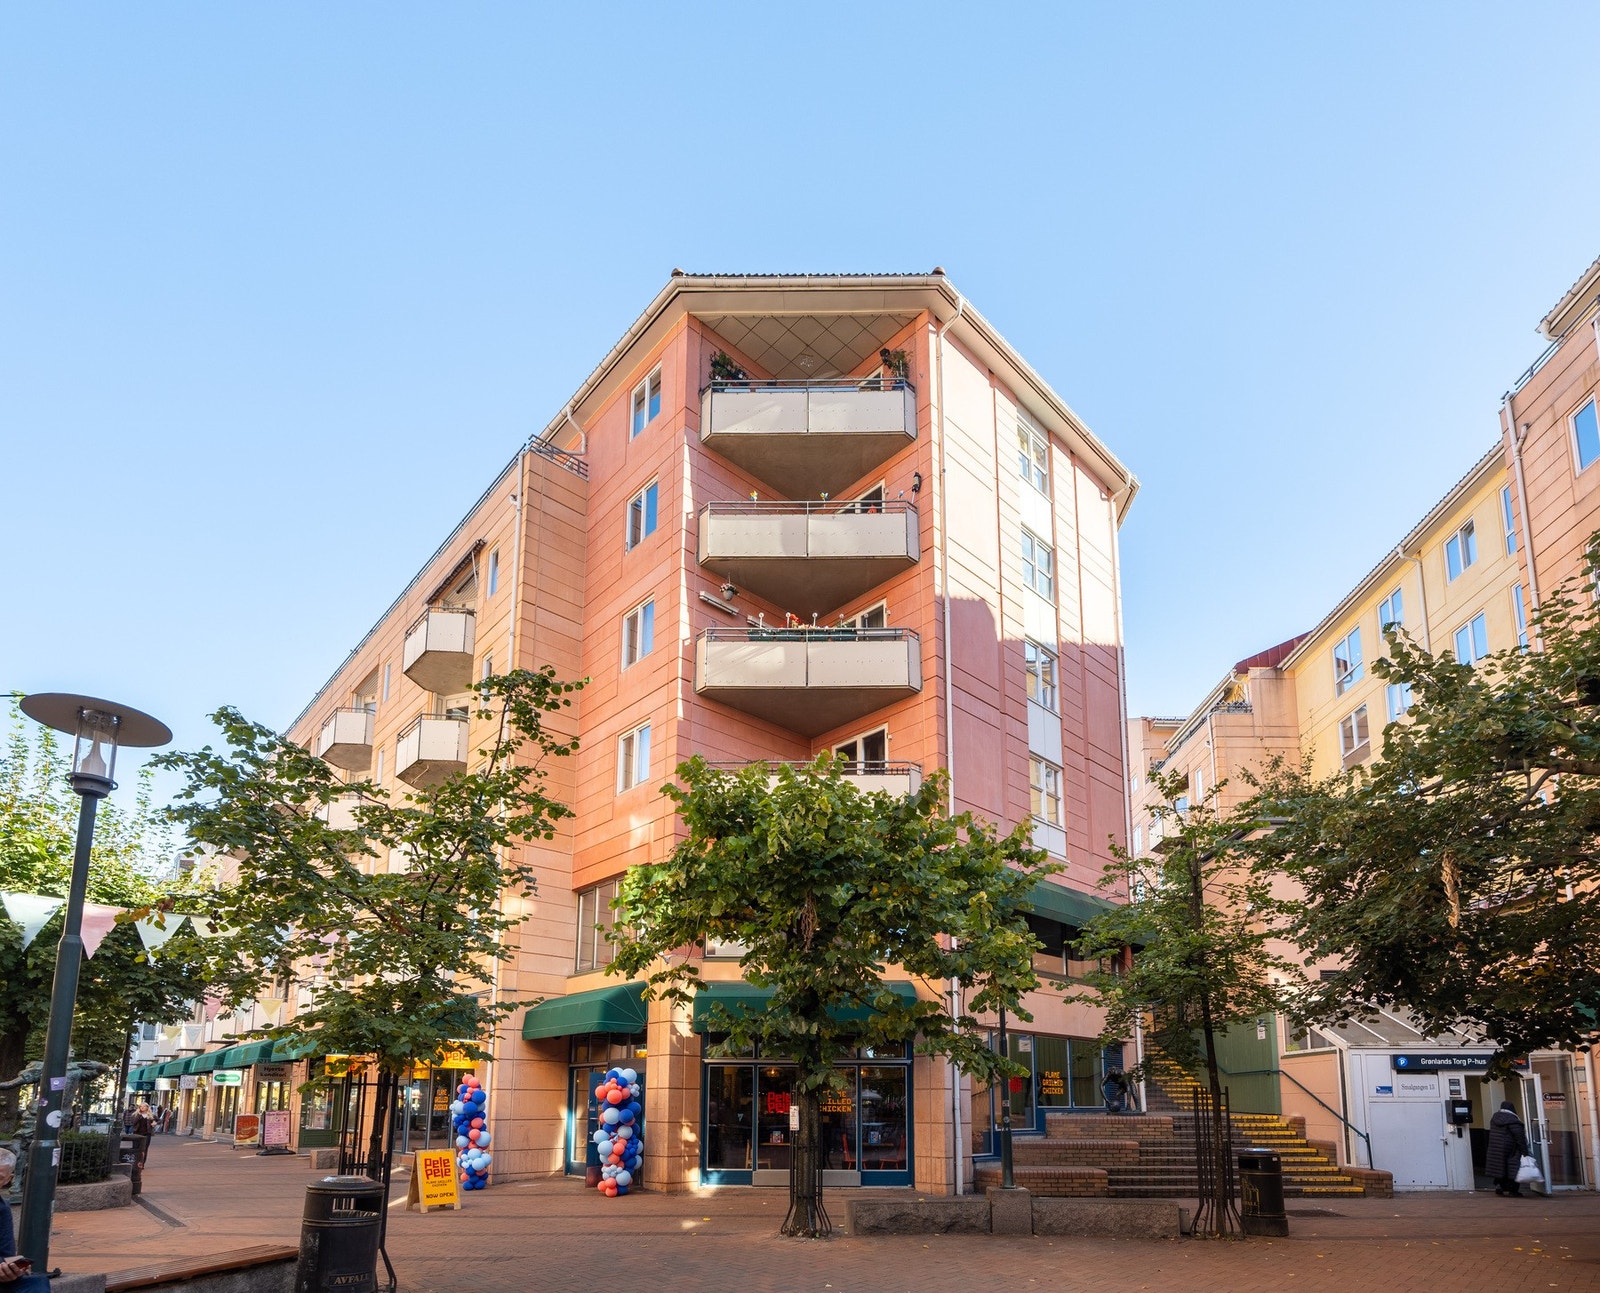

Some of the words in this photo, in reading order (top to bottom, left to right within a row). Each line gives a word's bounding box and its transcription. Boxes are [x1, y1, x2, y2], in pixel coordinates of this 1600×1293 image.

[1453, 1058, 1467, 1066] Torg
[1045, 1071, 1061, 1079] FLAME
[1042, 1079, 1064, 1087] GRILLED
[1042, 1087, 1064, 1095] CHICKEN
[424, 1157, 451, 1169] Pele
[425, 1168, 451, 1180] Pele
